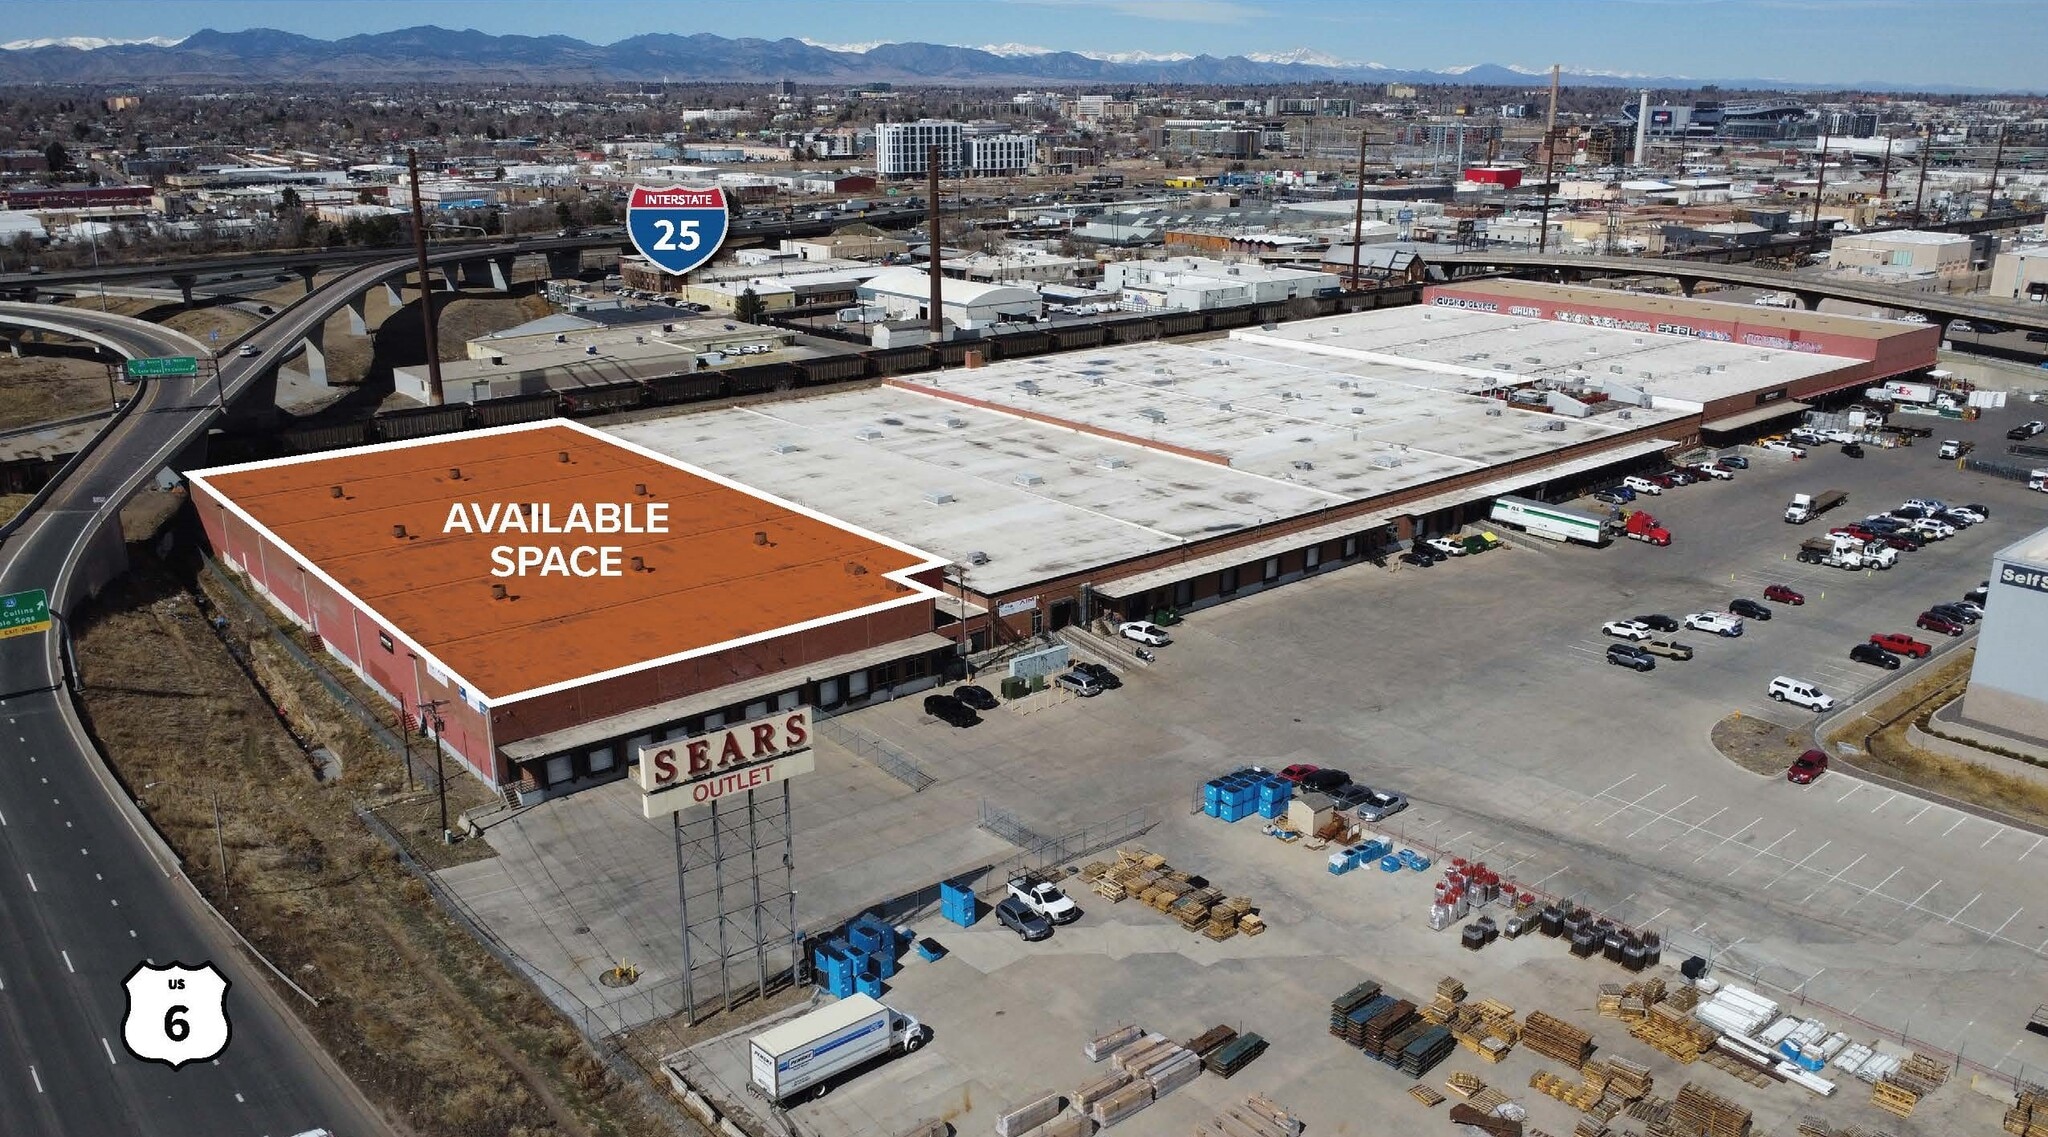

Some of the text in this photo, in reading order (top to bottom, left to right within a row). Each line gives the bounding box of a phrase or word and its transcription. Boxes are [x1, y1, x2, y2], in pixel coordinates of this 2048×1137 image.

[1886, 384, 1912, 396] FedEx
[3, 608, 34, 618] Collins
[15, 616, 36, 624] Spgs
[654, 713, 807, 785] SEARS
[693, 764, 774, 802] OUTLET
